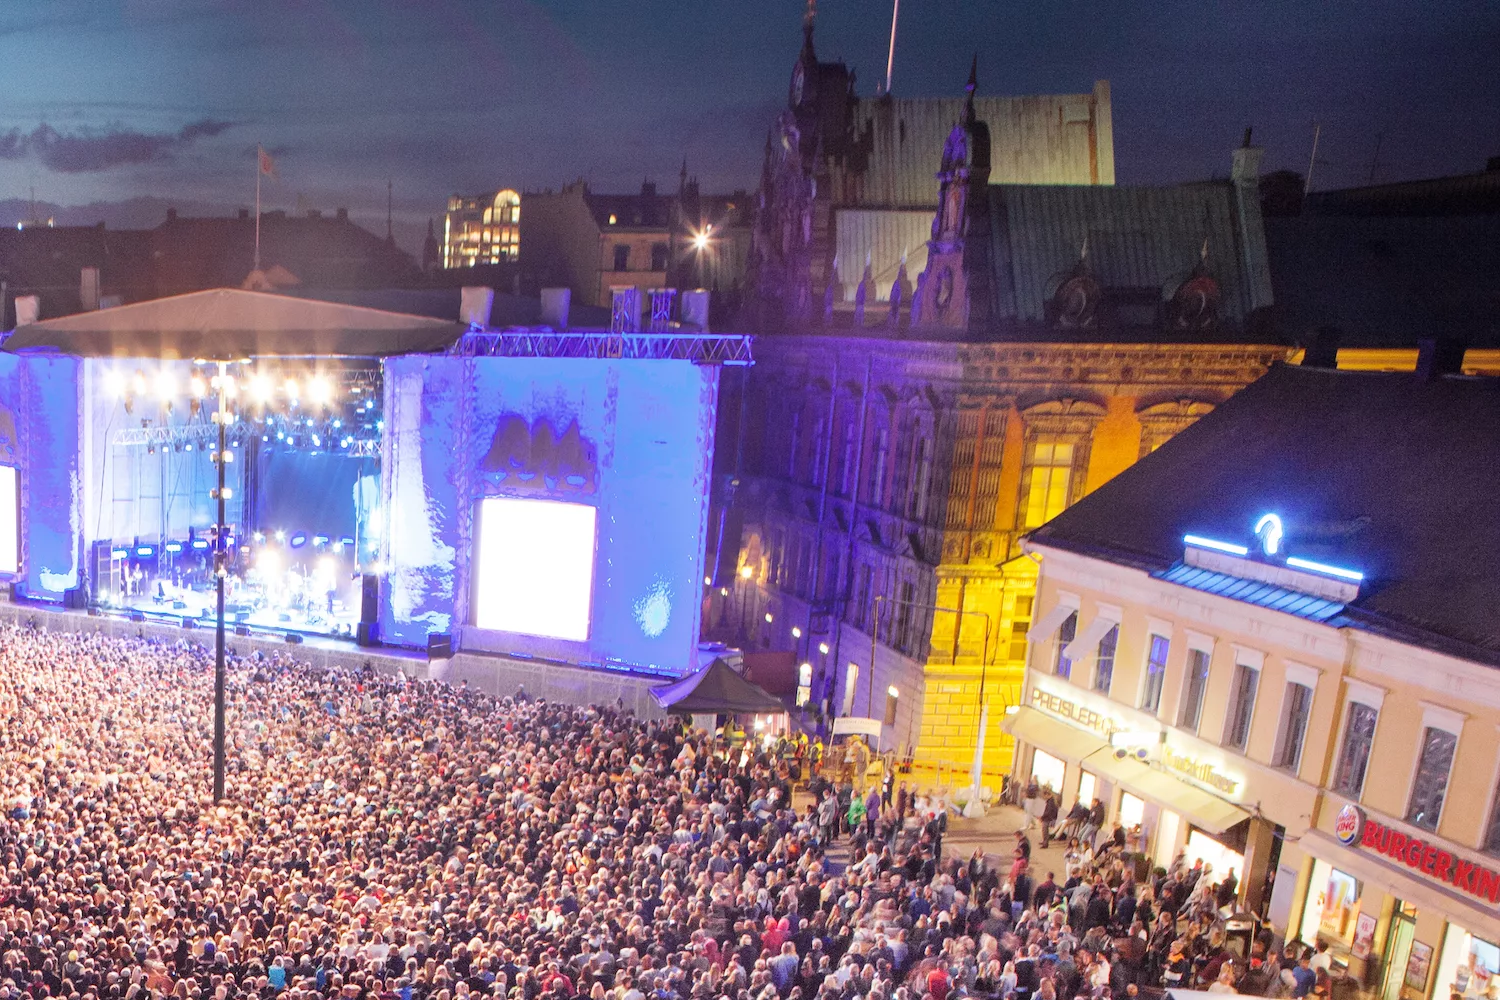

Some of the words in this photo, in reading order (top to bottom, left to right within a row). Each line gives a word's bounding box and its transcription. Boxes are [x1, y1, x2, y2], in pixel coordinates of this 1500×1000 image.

[1336, 821, 1355, 832] KING
[1361, 819, 1453, 883] BURGER
[1452, 859, 1500, 903] KIN
